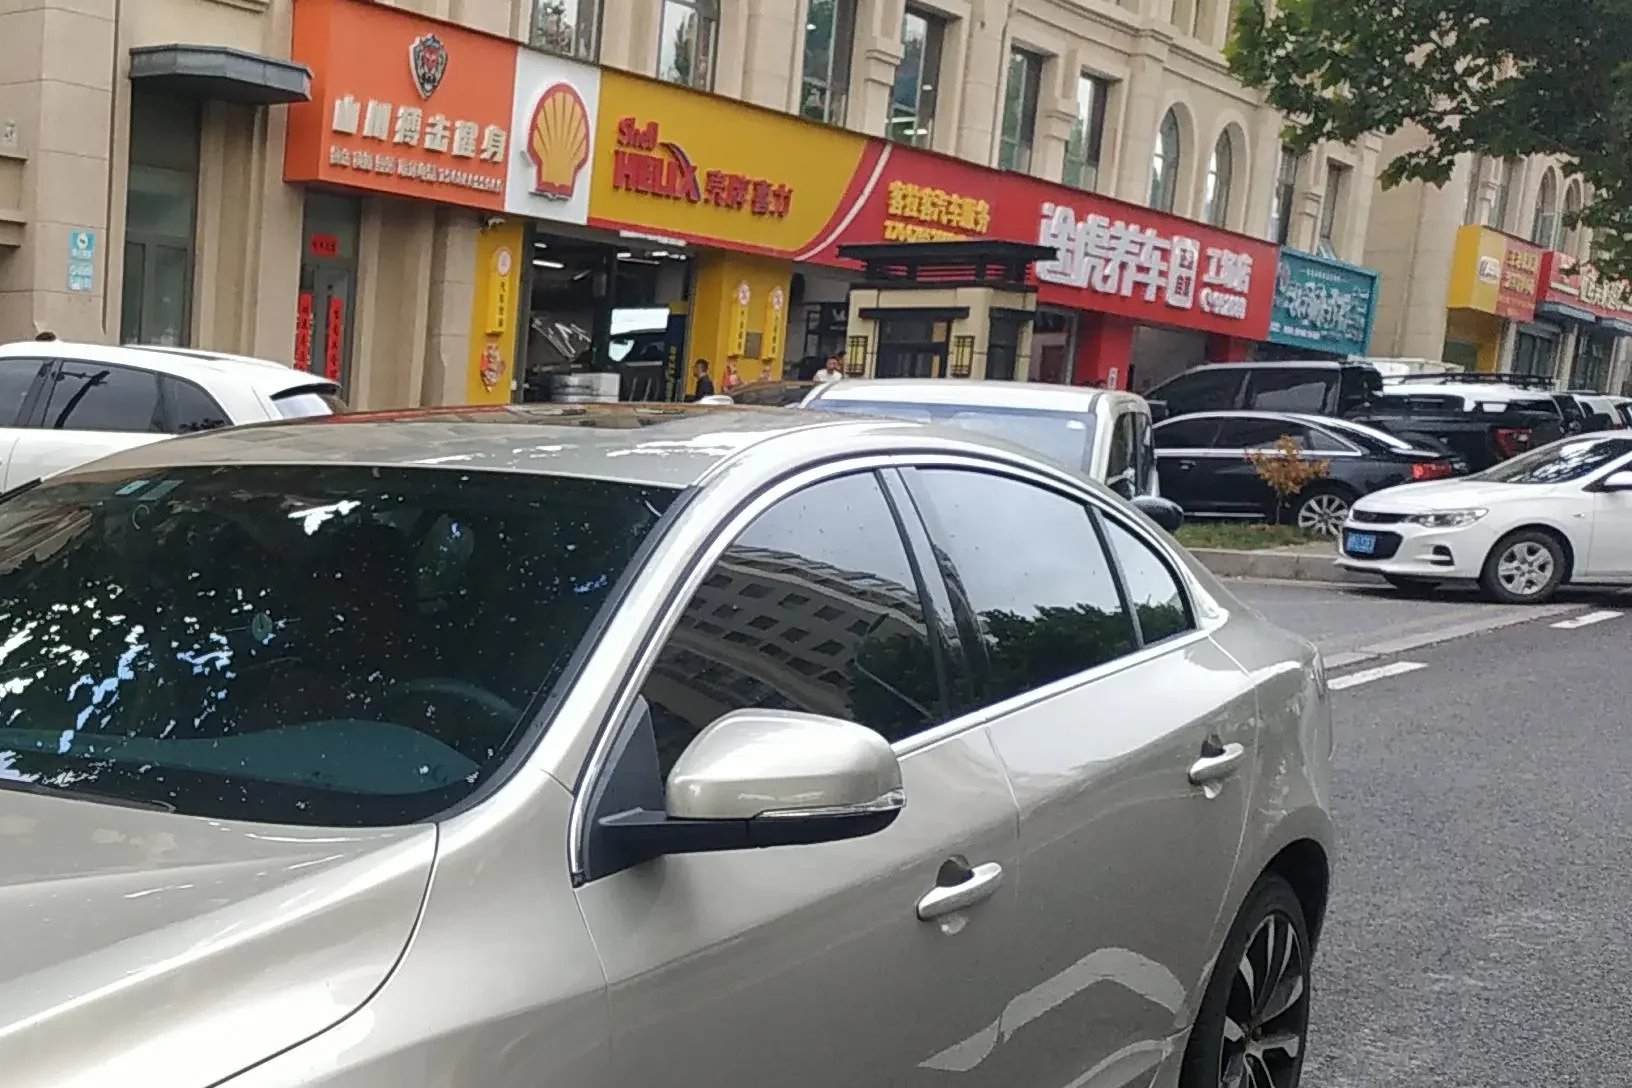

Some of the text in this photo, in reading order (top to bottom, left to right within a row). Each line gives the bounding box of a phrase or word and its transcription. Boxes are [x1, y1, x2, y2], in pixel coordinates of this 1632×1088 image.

[617, 117, 659, 151] Shell
[612, 149, 700, 204] HELIX
[1035, 201, 1173, 303] 途虎养车
